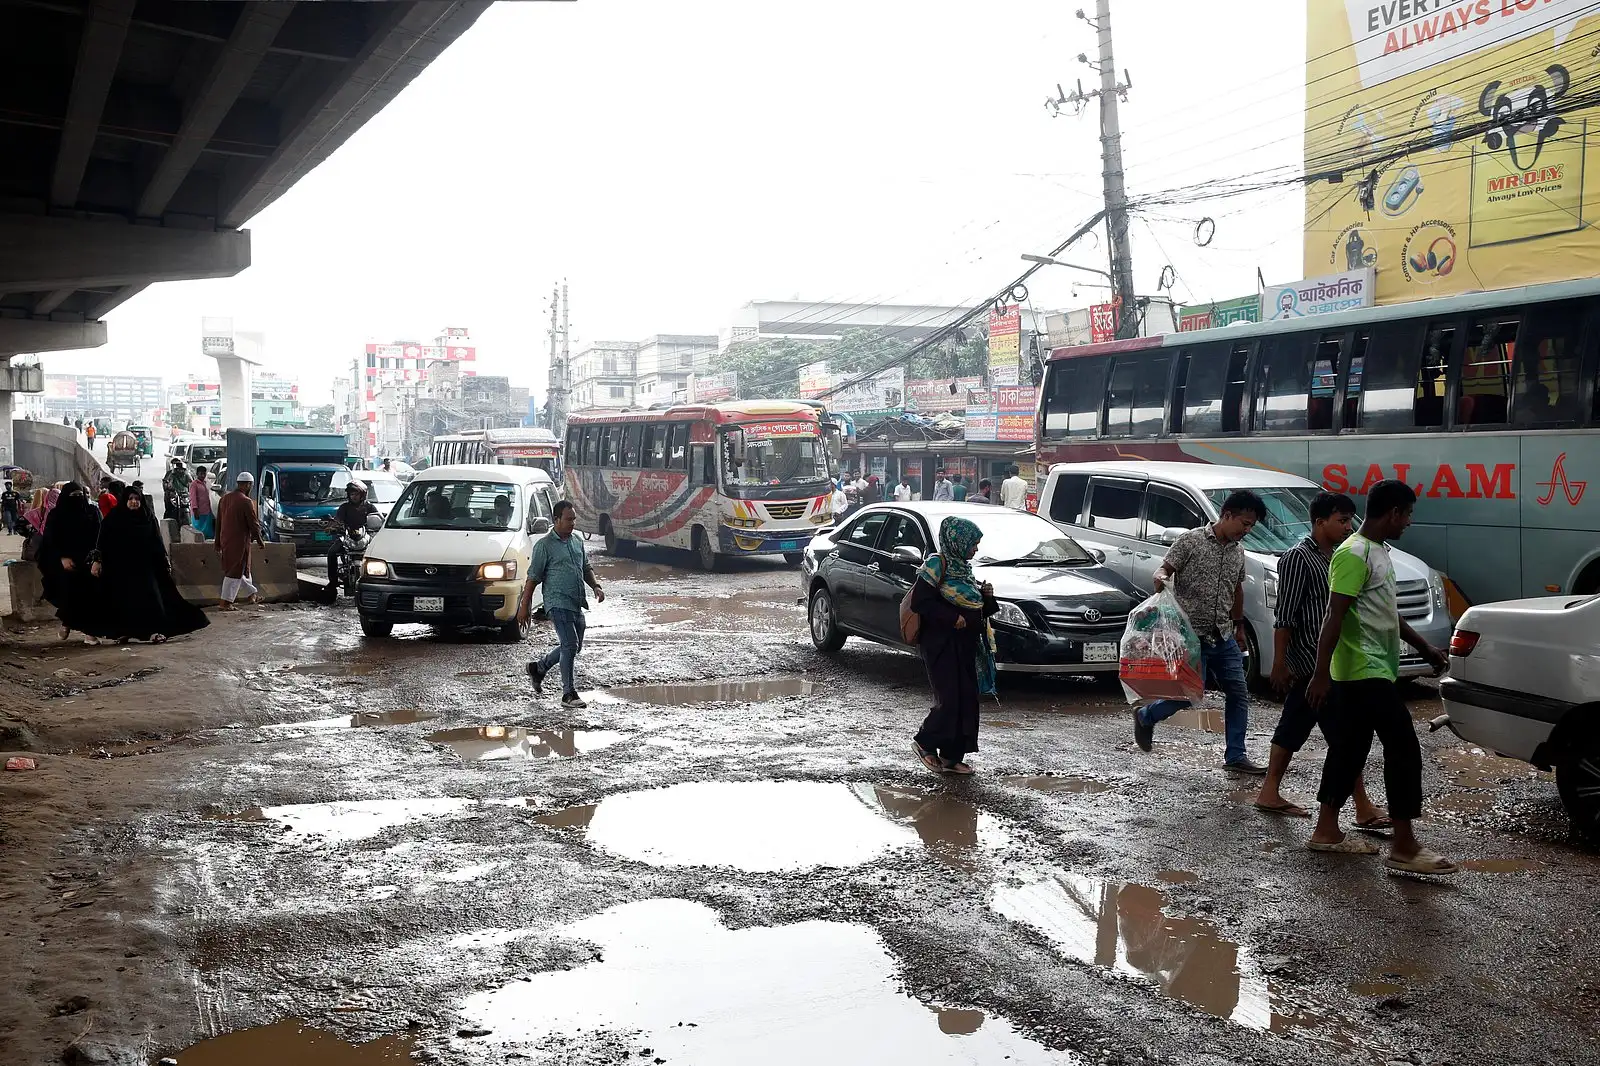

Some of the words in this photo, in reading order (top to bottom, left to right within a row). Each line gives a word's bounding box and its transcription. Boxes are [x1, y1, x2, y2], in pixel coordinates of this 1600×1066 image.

[1383, 0, 1490, 56] ALWAYS
[1409, 89, 1438, 128] Household
[1487, 191, 1516, 203] Always
[1517, 189, 1533, 198] Low
[1535, 184, 1562, 194] Prices
[1333, 220, 1364, 250] Accessories
[1401, 243, 1412, 282] Computer
[1410, 225, 1419, 237] HP
[1420, 219, 1457, 238] Accessories
[1298, 277, 1363, 303] আইকনিক
[999, 388, 1020, 405] ঢাকা
[771, 423, 798, 433] গোল্ডেন
[799, 422, 814, 432] সিটি
